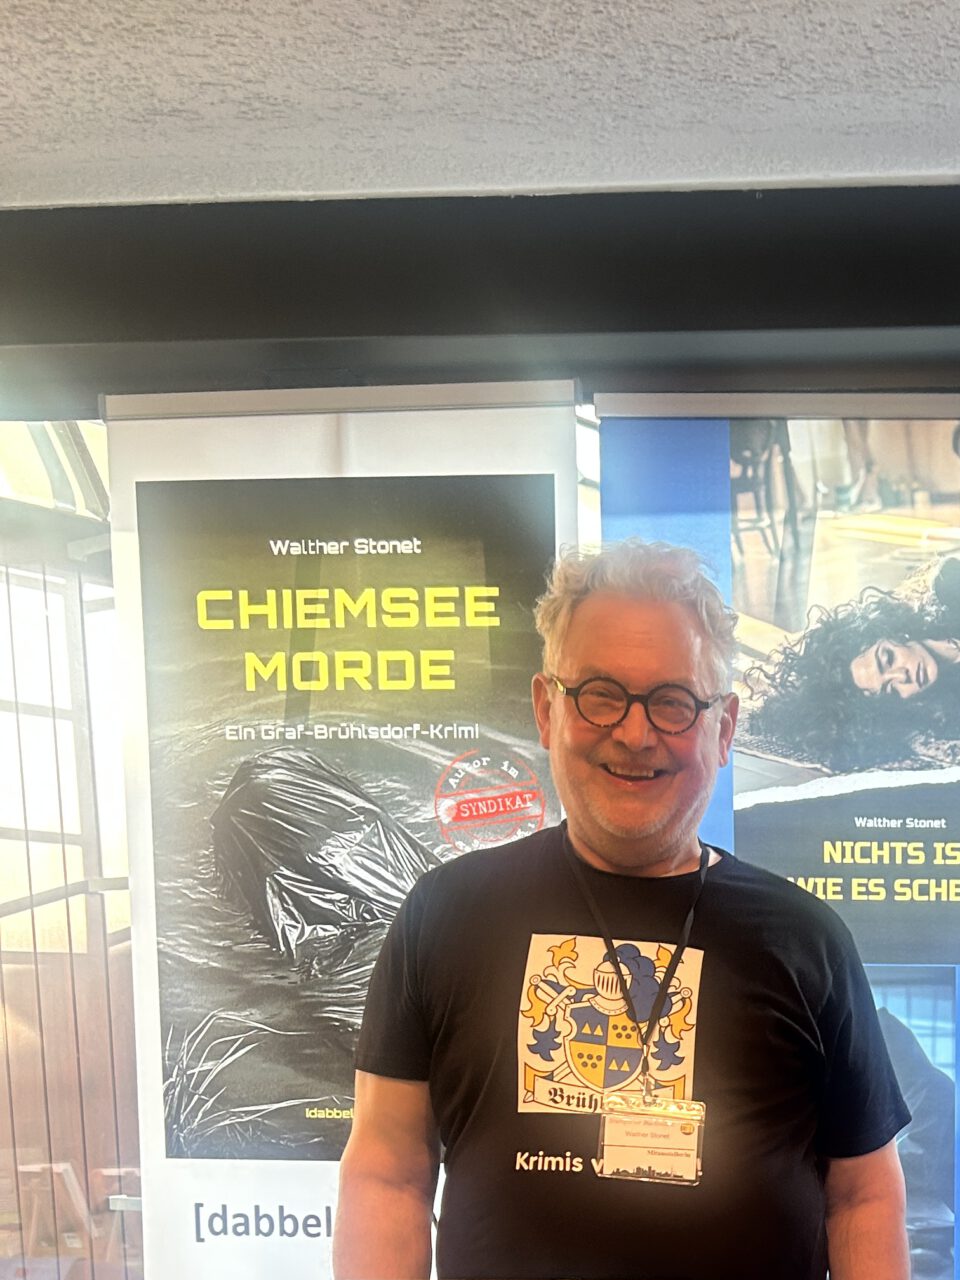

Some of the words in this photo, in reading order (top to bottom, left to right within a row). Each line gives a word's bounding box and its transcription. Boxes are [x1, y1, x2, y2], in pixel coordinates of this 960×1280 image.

[269, 539, 349, 555] Walther
[354, 537, 422, 555] Stonet
[196, 586, 501, 630] CHIEMSEE
[245, 649, 456, 691] MORDE
[225, 726, 256, 740] Ein
[261, 723, 479, 741] Graf-Brühlsdorf-Krimi
[448, 756, 491, 789] Autor
[459, 793, 534, 817] SYNDIKAT
[854, 816, 903, 828] Walther
[906, 817, 947, 829] Stonet
[823, 841, 925, 865] NICHTS
[851, 878, 886, 901] ES
[515, 1151, 583, 1172] Krimis
